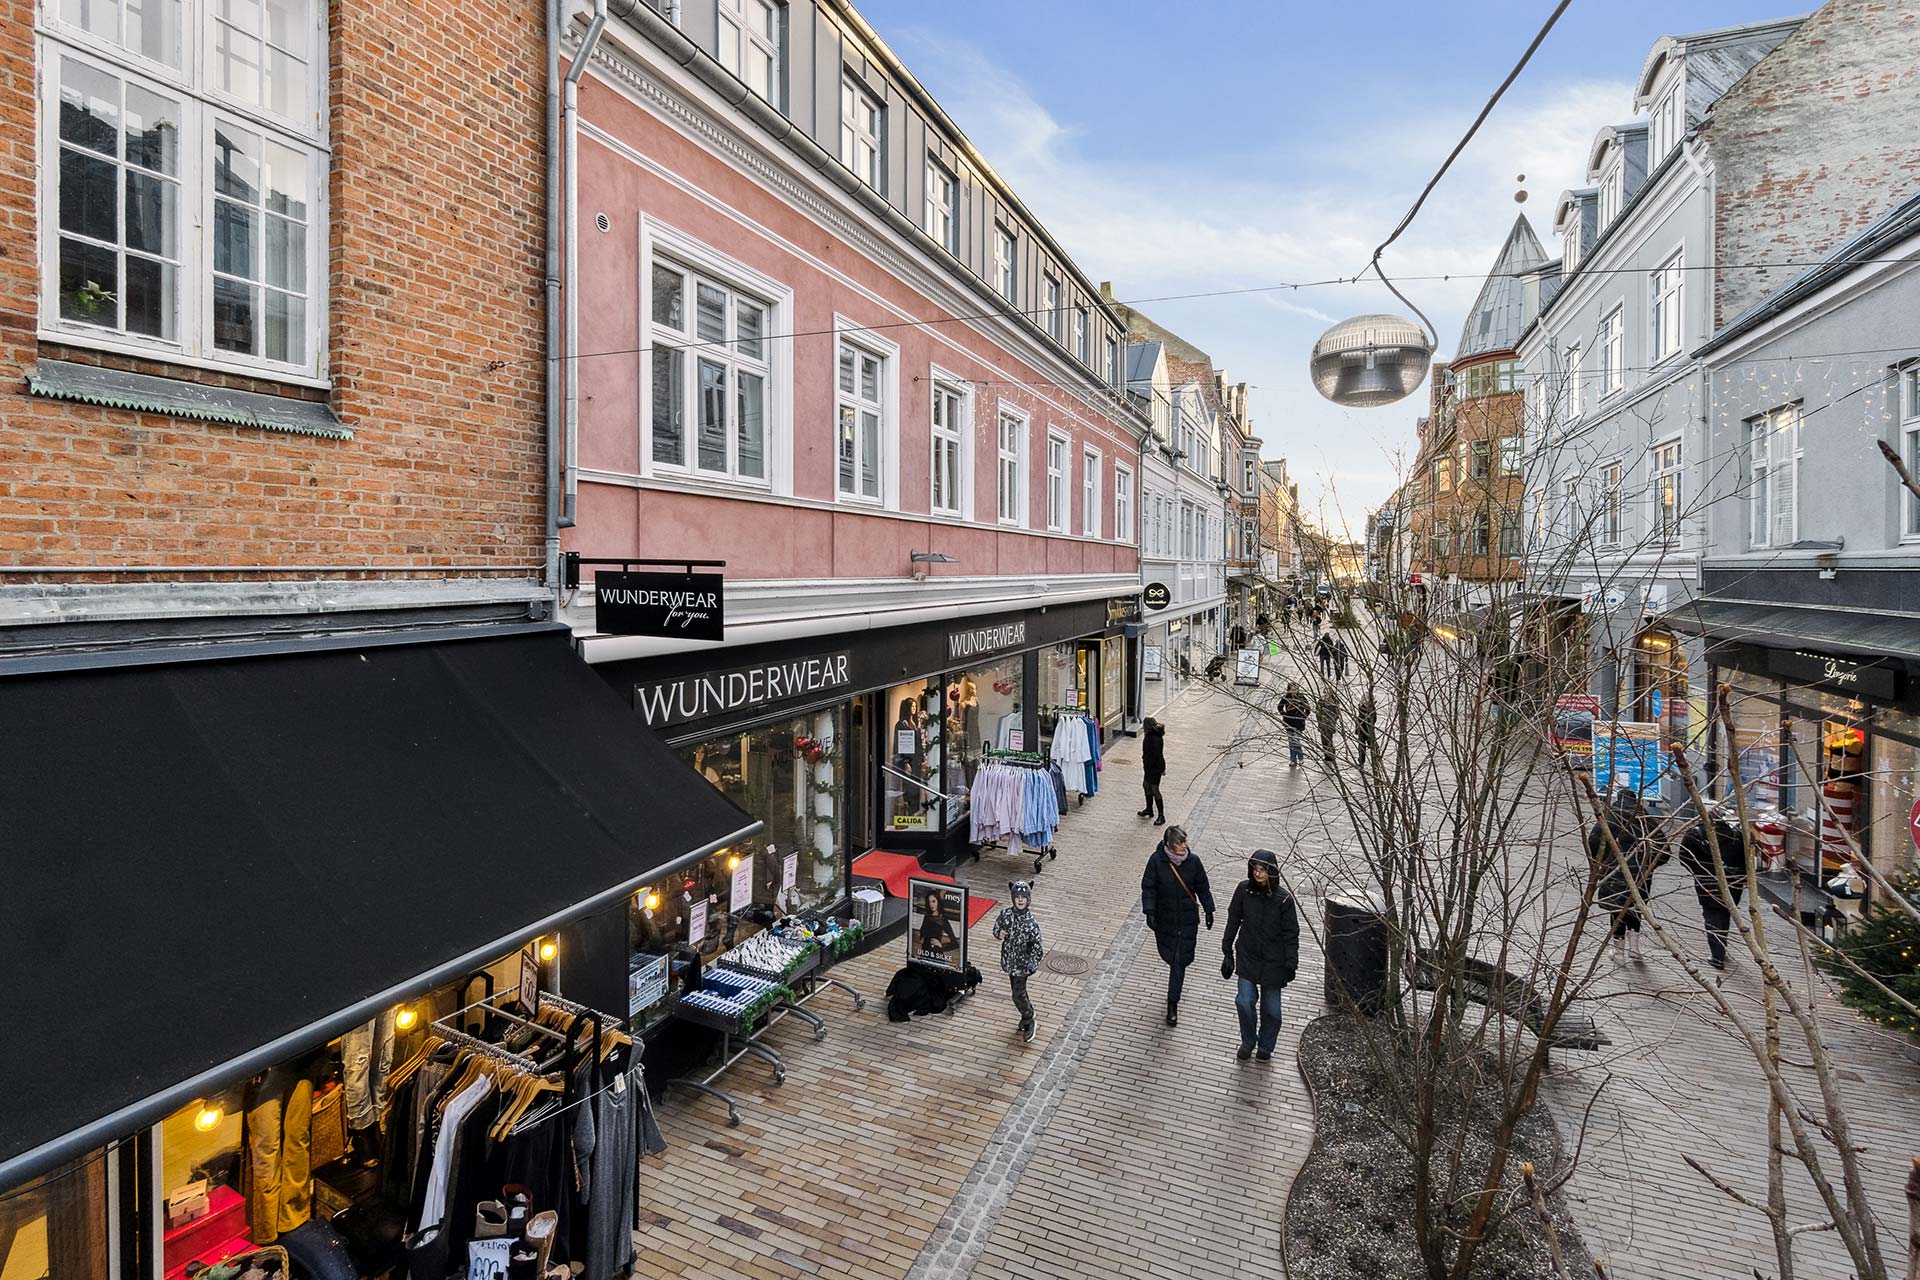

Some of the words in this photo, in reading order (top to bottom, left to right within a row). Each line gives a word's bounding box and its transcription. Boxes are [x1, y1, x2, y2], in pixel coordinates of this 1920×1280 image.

[600, 588, 718, 608] WUNDERWEAR
[663, 601, 684, 627] for
[681, 610, 710, 628] you.
[949, 624, 1025, 657] WUNDERWEAR
[1823, 661, 1858, 685] Lingerie
[637, 654, 850, 726] WUNDERWEAR
[896, 817, 922, 825] CALIDA
[944, 893, 961, 904] mey
[917, 948, 929, 957] ULD
[935, 952, 953, 962] SILKE
